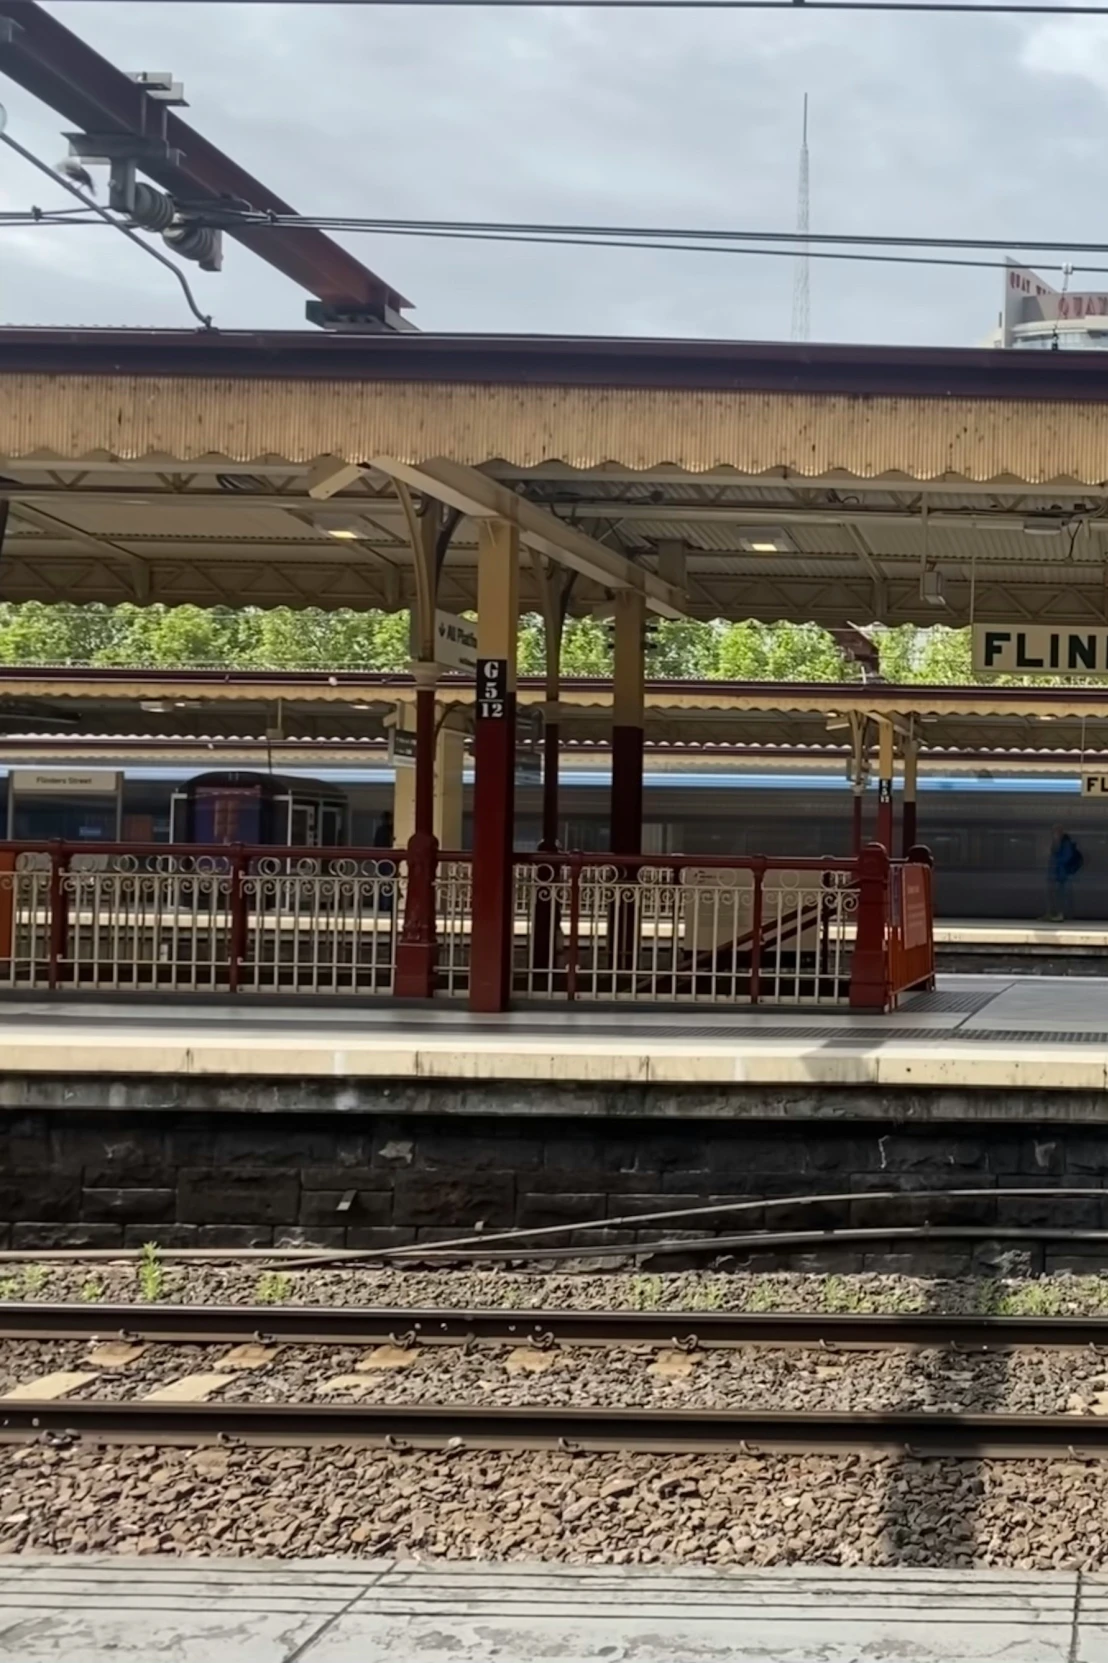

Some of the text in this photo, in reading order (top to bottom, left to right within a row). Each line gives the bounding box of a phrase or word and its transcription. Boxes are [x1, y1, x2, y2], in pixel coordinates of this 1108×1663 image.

[1058, 296, 1108, 320] QUAY
[484, 661, 499, 679] G
[485, 682, 498, 699] 5
[481, 703, 503, 717] 12
